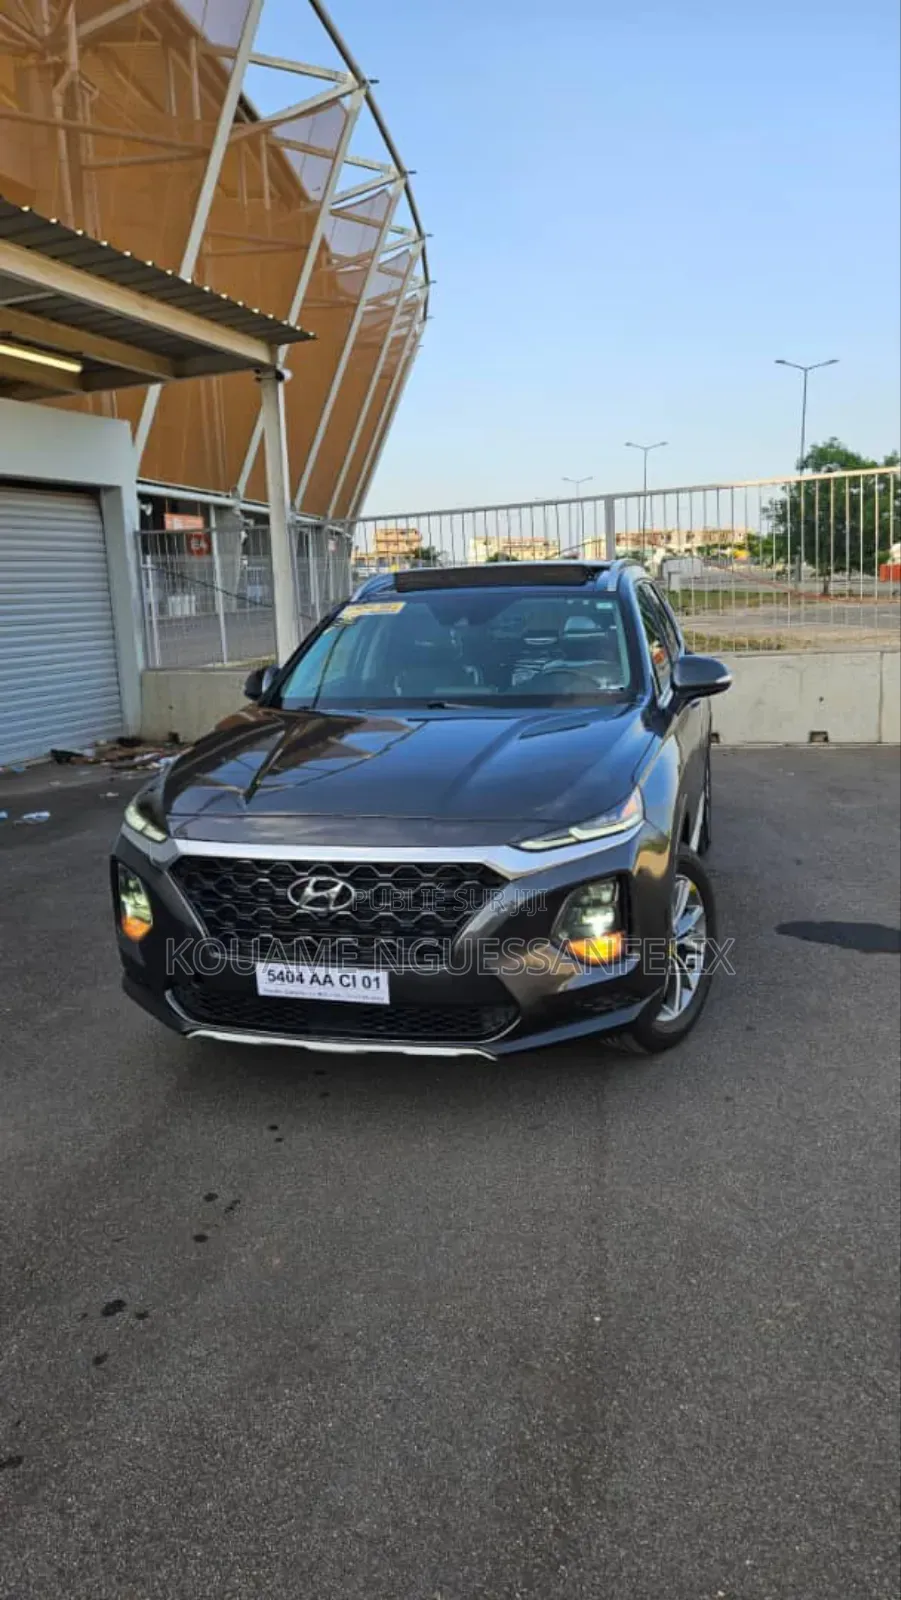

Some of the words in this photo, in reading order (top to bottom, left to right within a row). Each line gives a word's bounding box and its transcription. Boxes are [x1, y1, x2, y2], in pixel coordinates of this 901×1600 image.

[267, 969, 304, 984] 5404
[309, 974, 334, 987] AA
[339, 974, 356, 988] CI
[362, 976, 380, 989] 01
